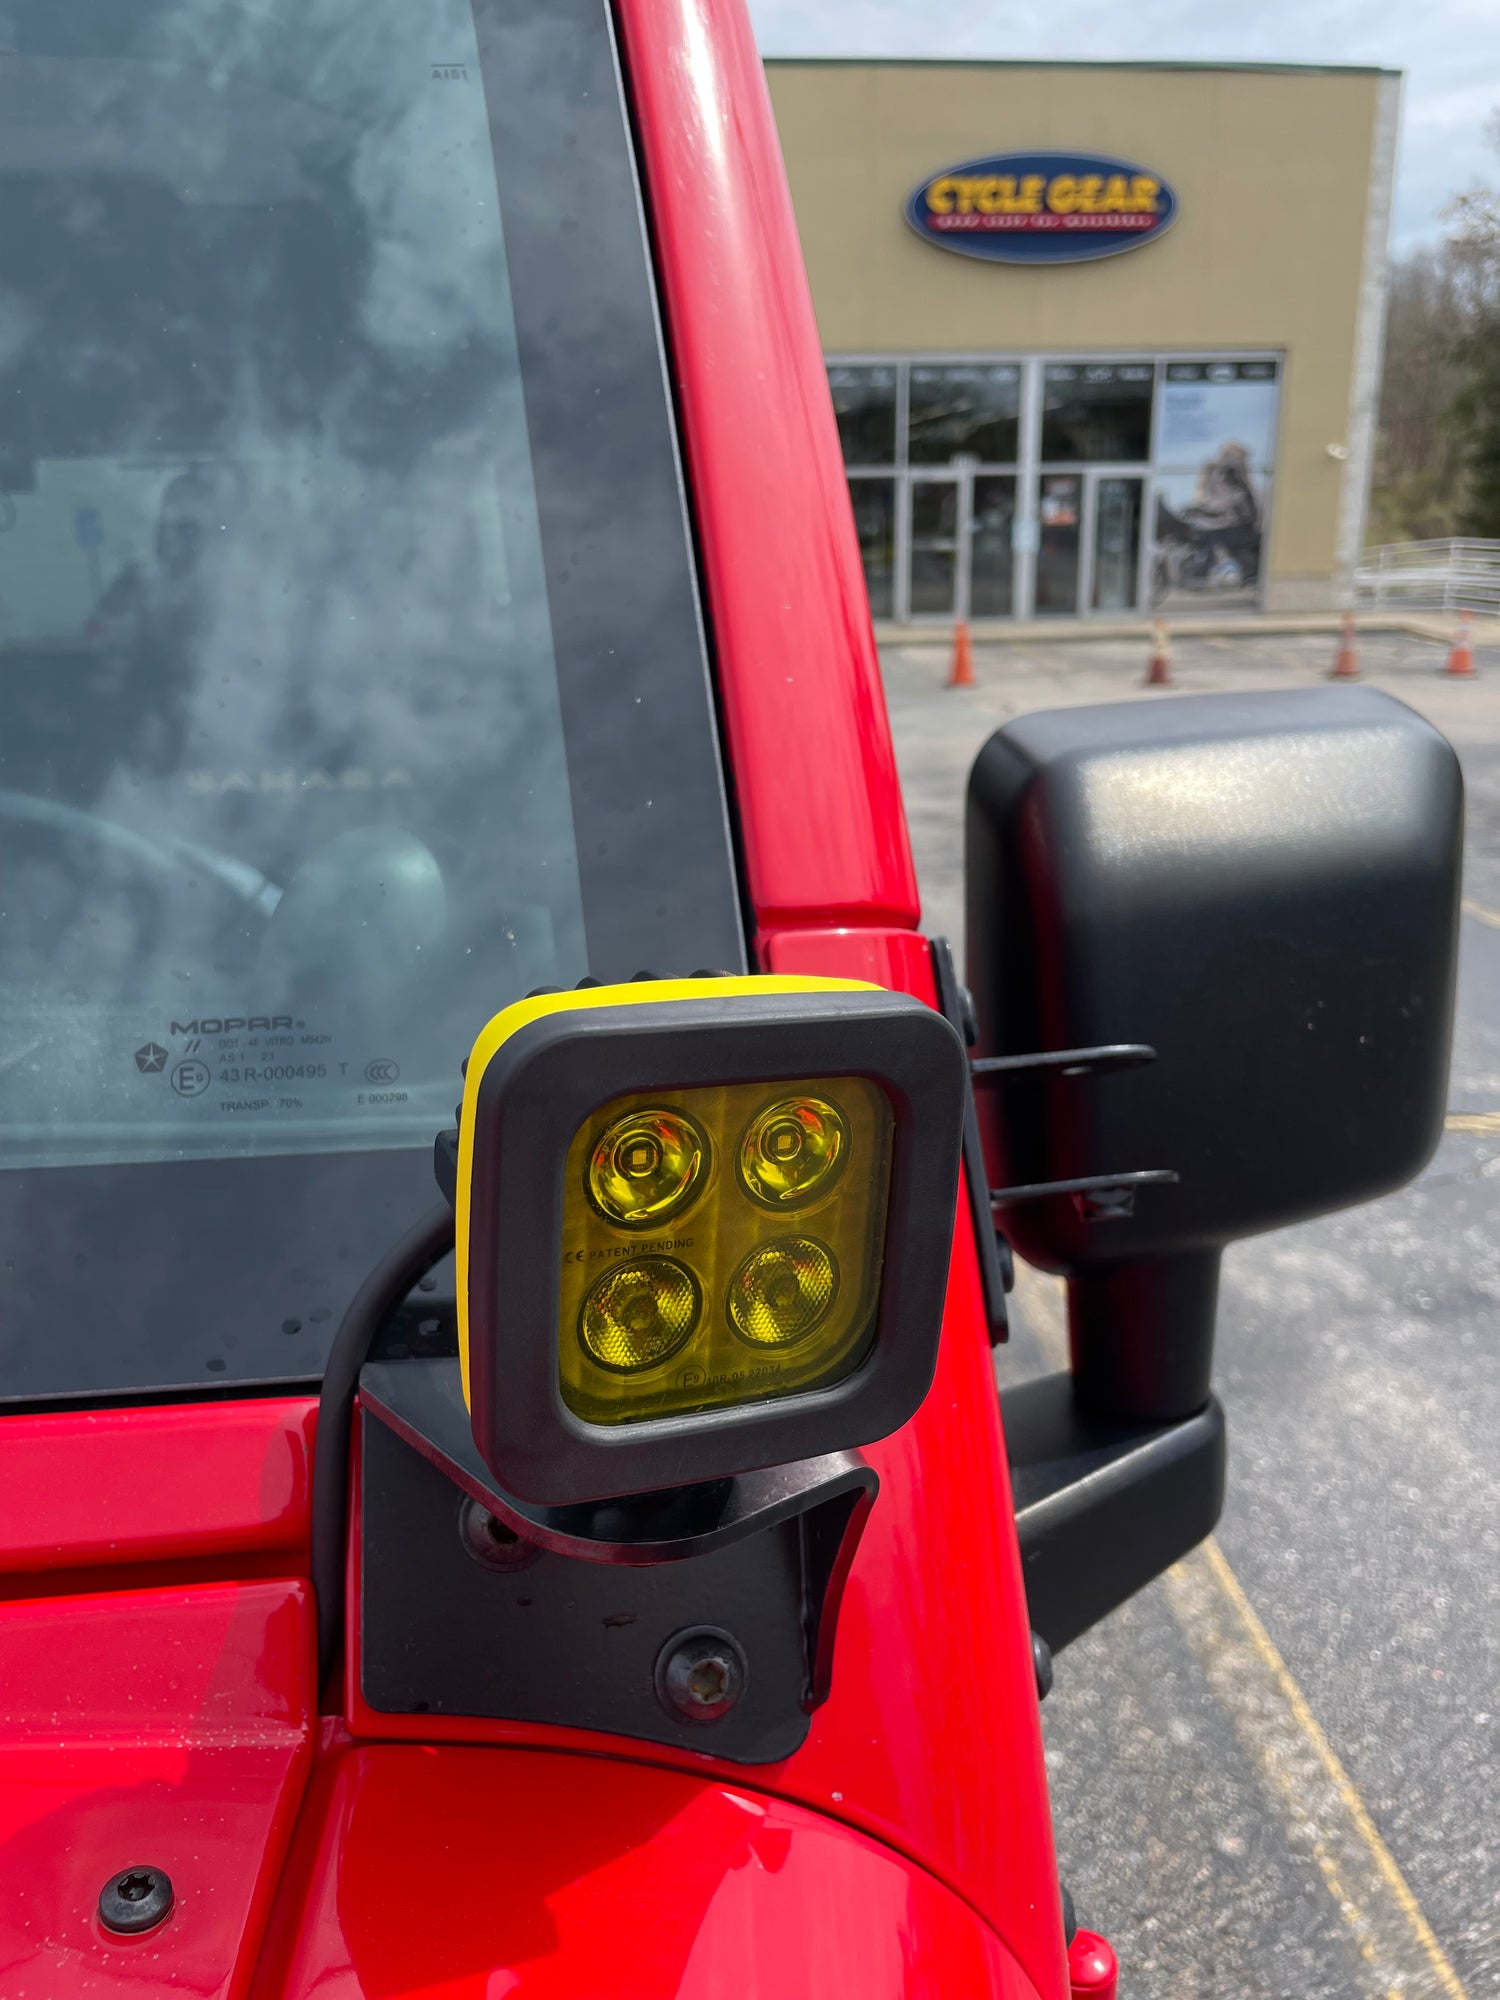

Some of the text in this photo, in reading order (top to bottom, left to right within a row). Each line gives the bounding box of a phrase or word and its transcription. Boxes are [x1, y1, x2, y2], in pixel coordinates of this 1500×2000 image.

[926, 174, 1161, 215] CYCLE GEAR
[170, 1016, 293, 1036] MOPAR
[339, 1062, 350, 1076] T
[589, 1245, 639, 1261] PATENT
[641, 1237, 695, 1254] PENDING
